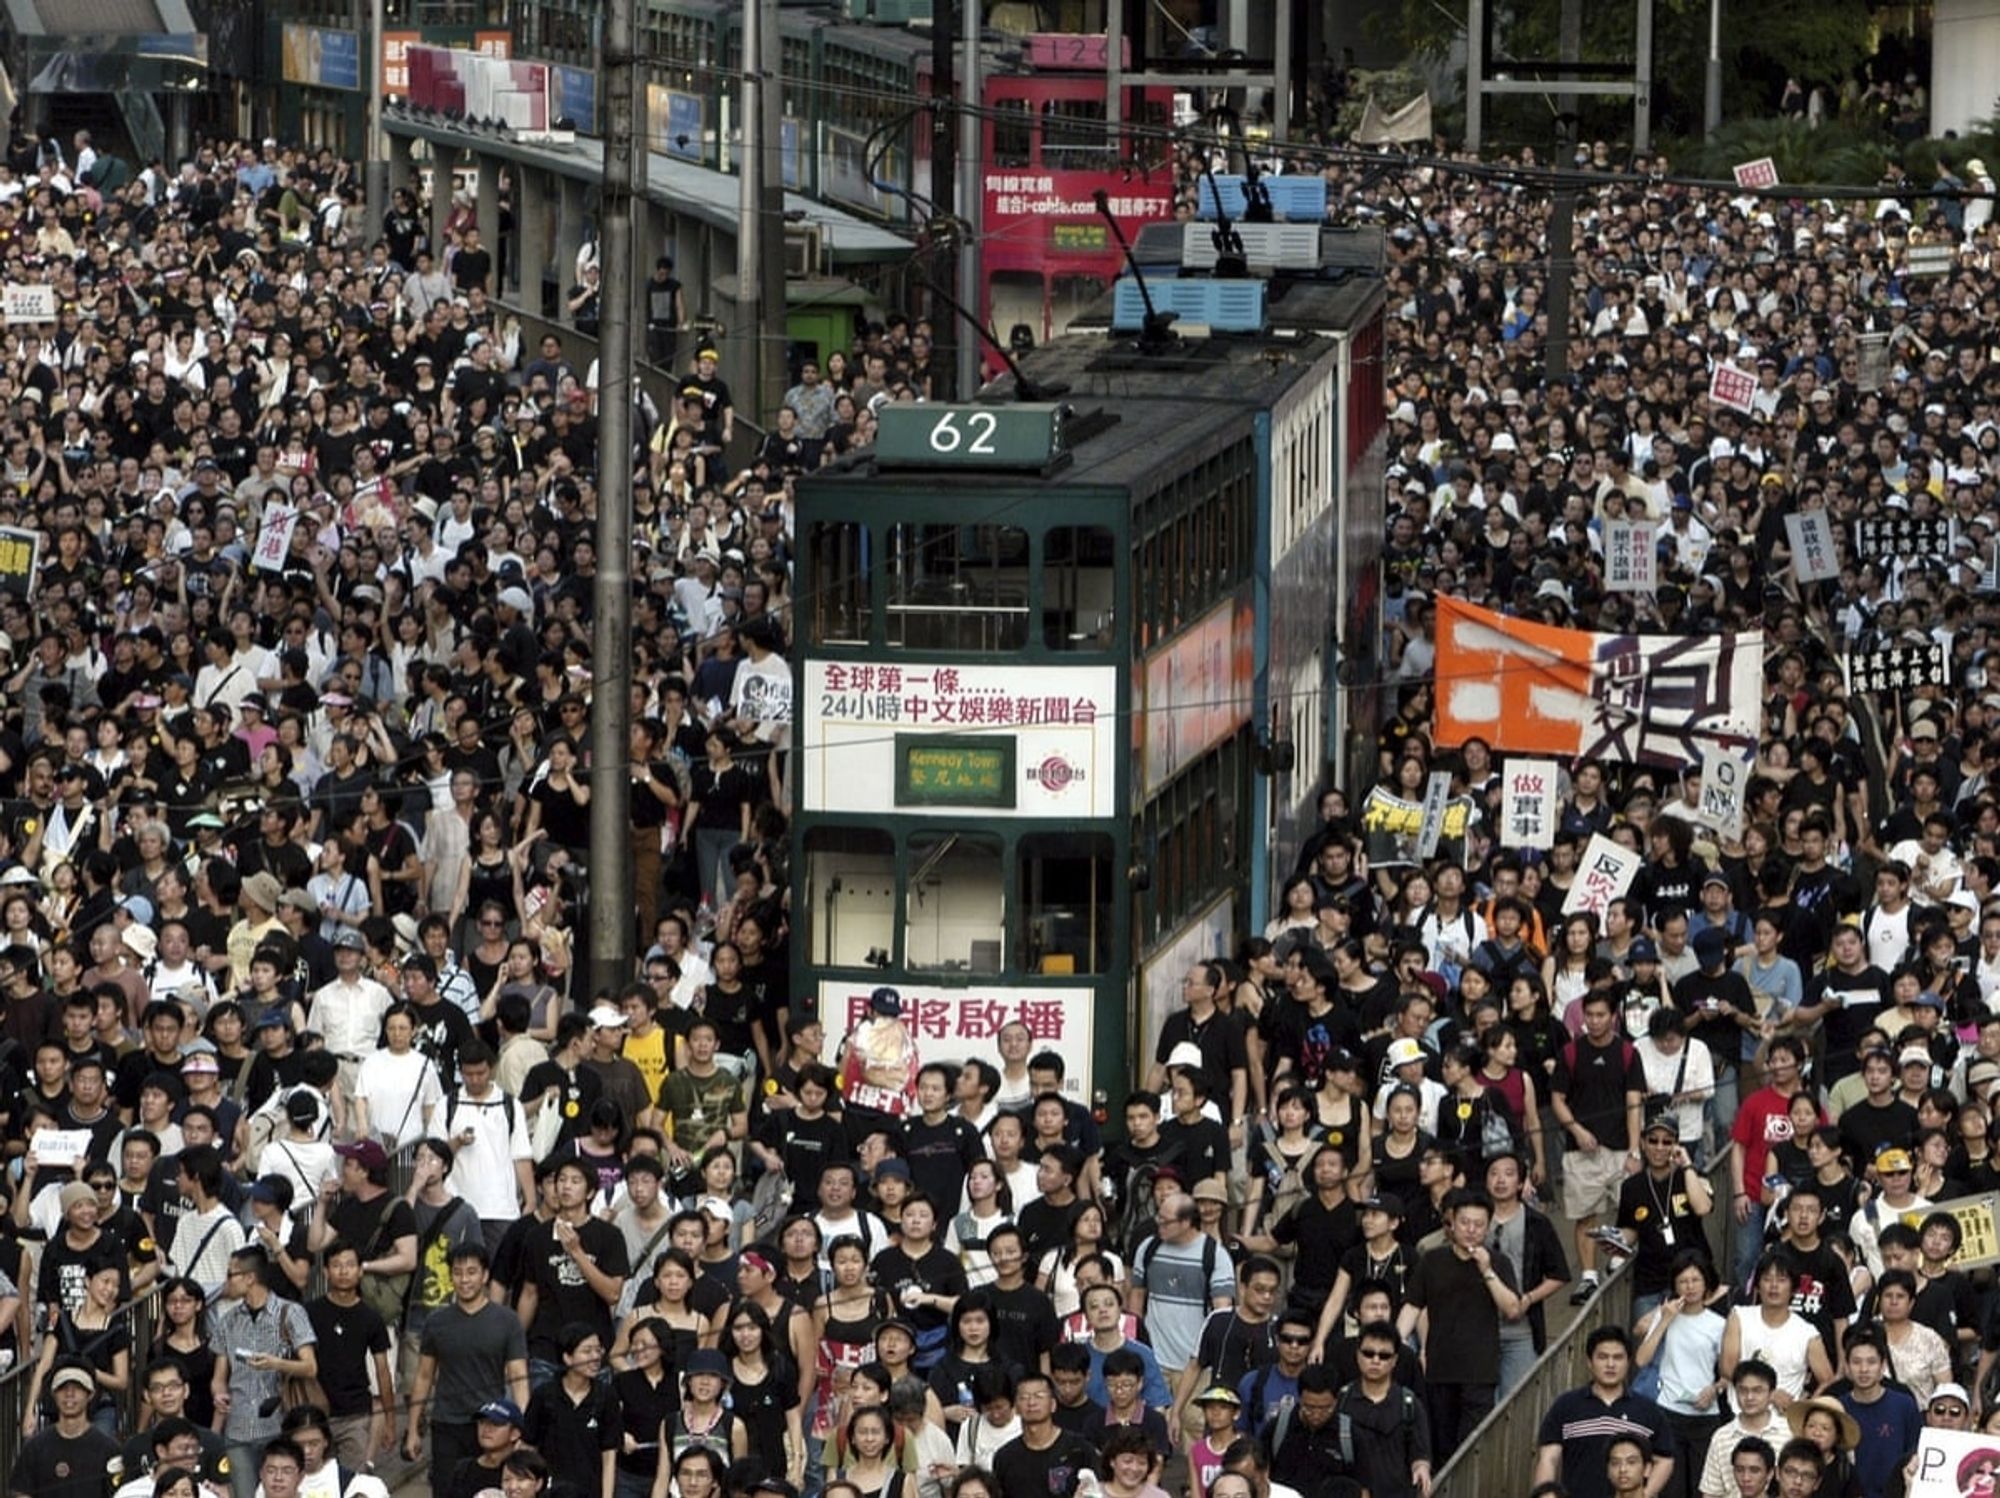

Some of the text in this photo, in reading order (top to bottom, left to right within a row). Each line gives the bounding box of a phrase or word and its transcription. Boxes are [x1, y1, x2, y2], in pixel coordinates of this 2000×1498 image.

[930, 412, 997, 453] 62
[820, 693, 1098, 725] 24小時中文娛樂新聞台
[909, 750, 999, 769] Kennedy Town
[1511, 772, 1545, 838] 做實事
